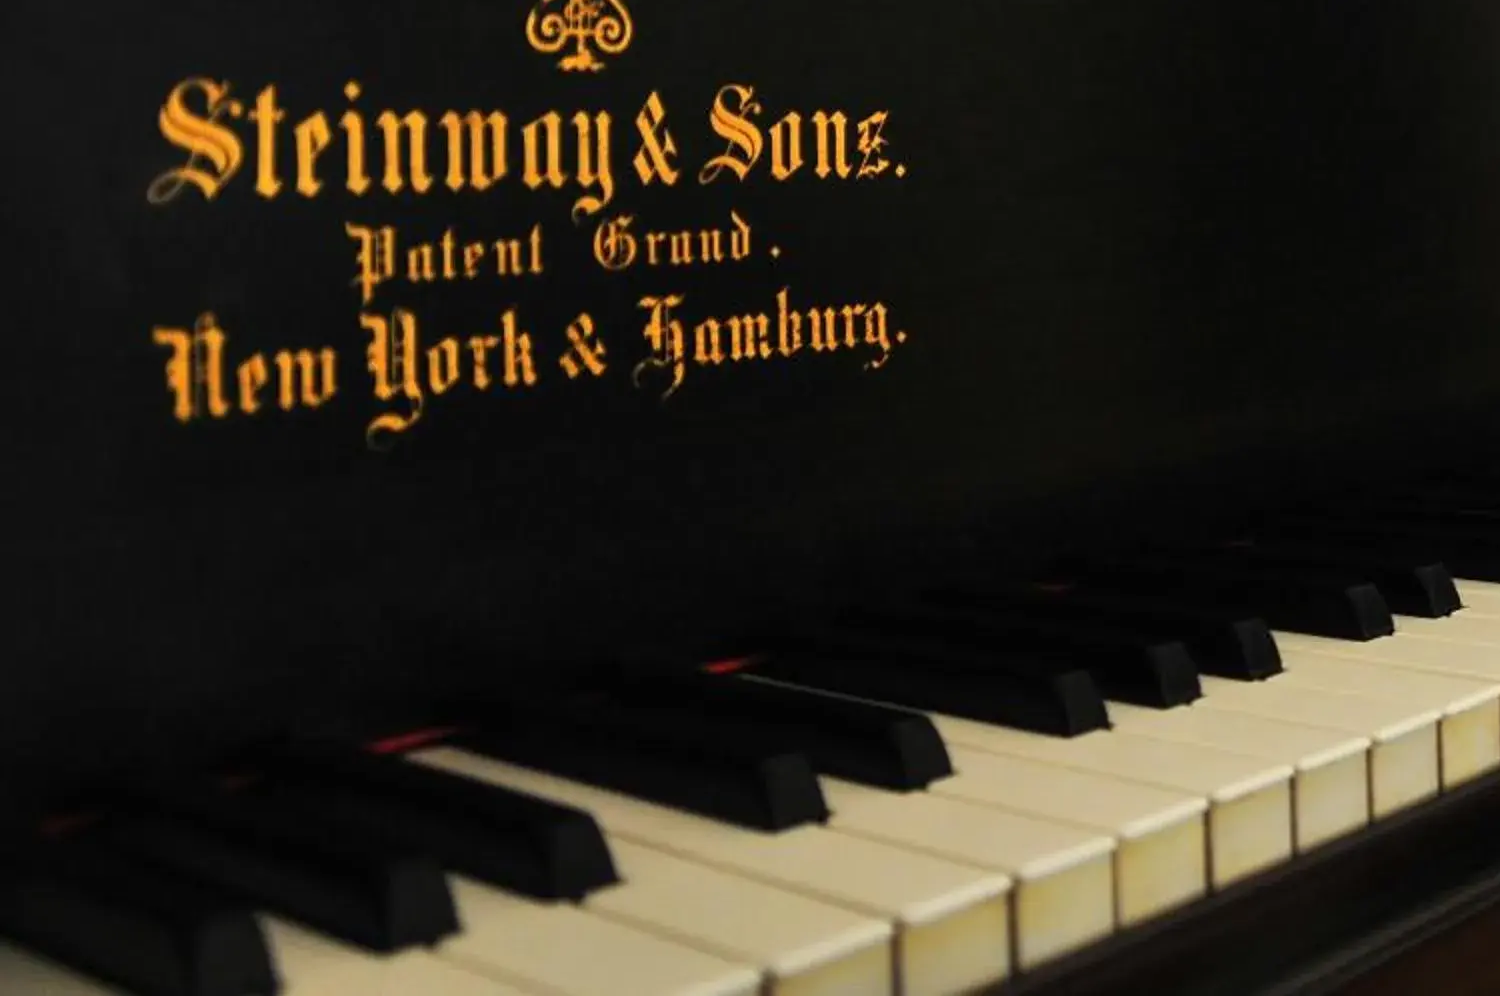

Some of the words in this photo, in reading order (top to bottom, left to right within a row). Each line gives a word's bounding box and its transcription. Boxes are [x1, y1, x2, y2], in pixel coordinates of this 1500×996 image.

[147, 77, 615, 222] Steinway
[633, 90, 680, 187] &
[345, 222, 543, 304] Patent
[152, 310, 338, 422] New
[360, 308, 539, 450] York
[558, 312, 608, 379] &
[634, 287, 908, 400] Hamburg.
